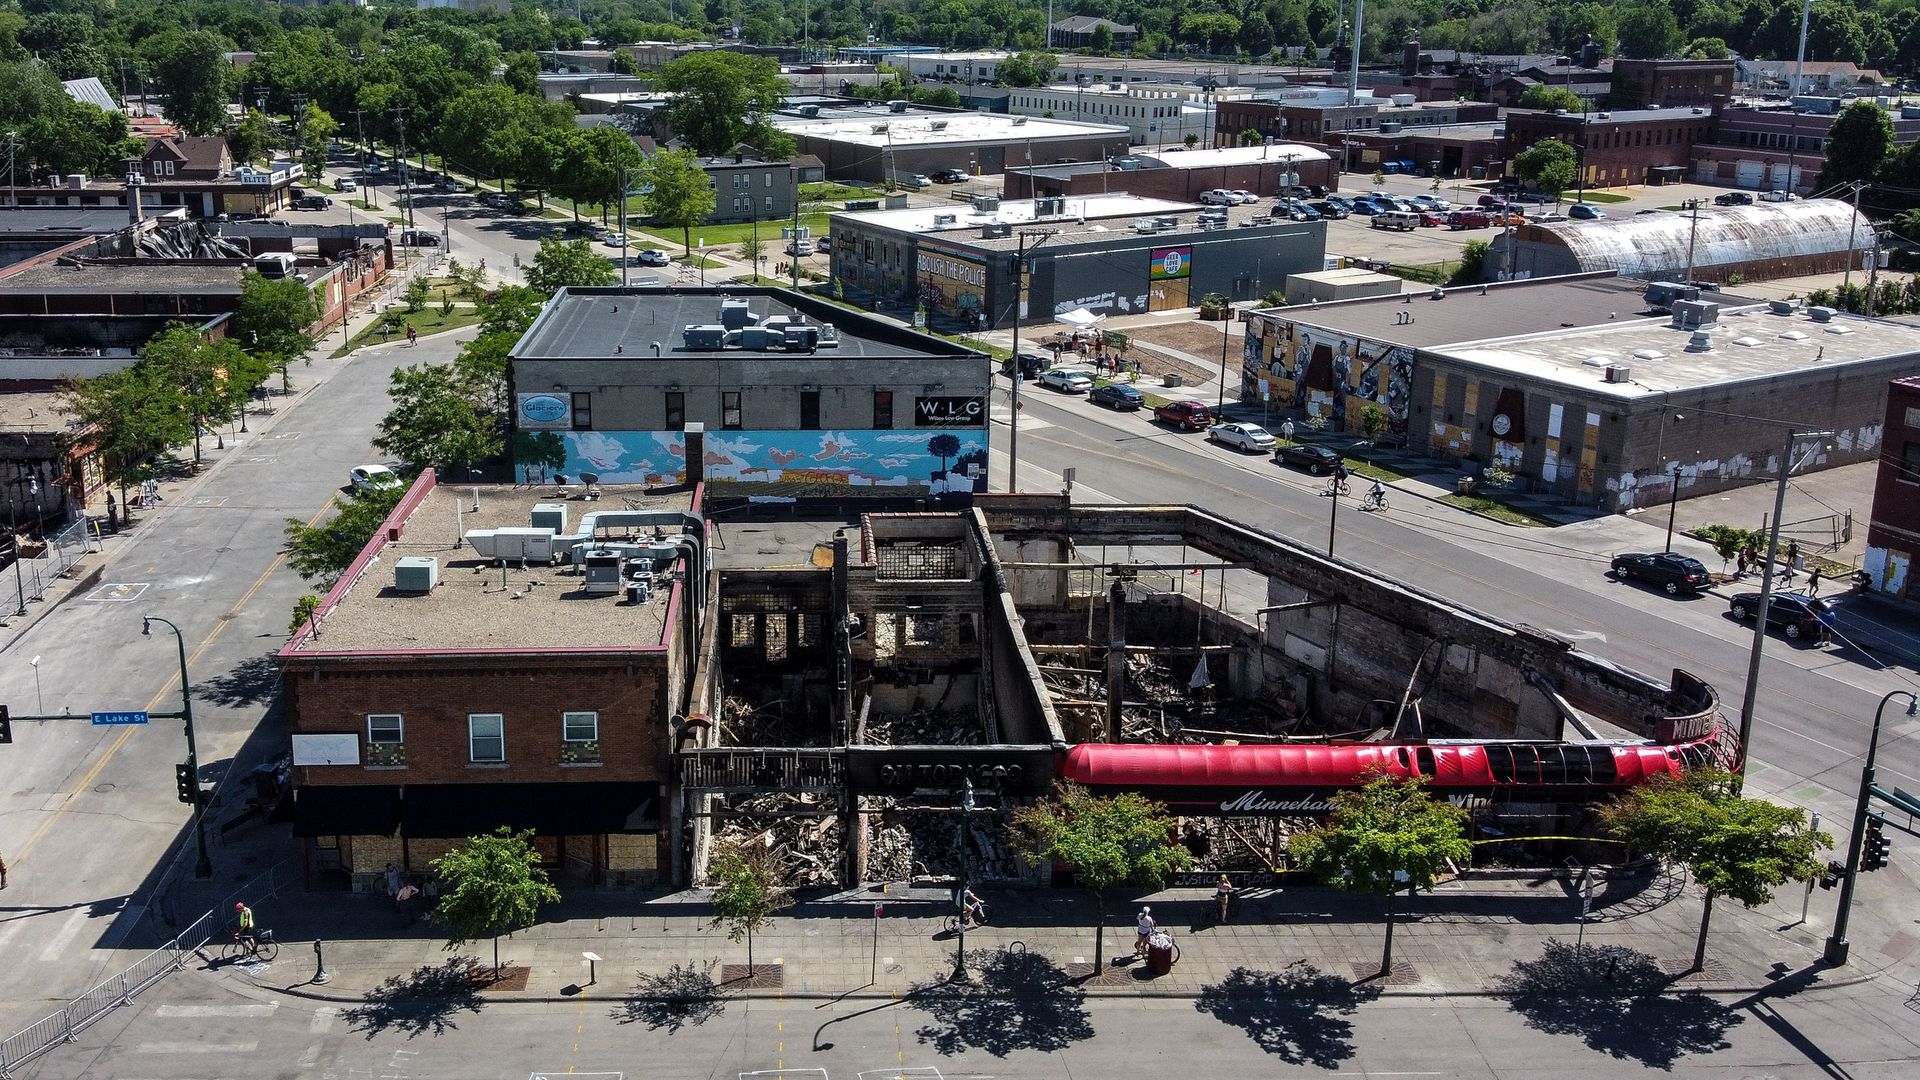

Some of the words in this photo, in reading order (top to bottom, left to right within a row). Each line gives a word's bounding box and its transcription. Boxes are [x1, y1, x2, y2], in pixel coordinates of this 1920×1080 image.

[917, 254, 945, 275] ABOLISH
[945, 260, 958, 280] THE
[959, 263, 986, 288] POLICE
[94, 715, 101, 723] E
[105, 714, 129, 722] Lake
